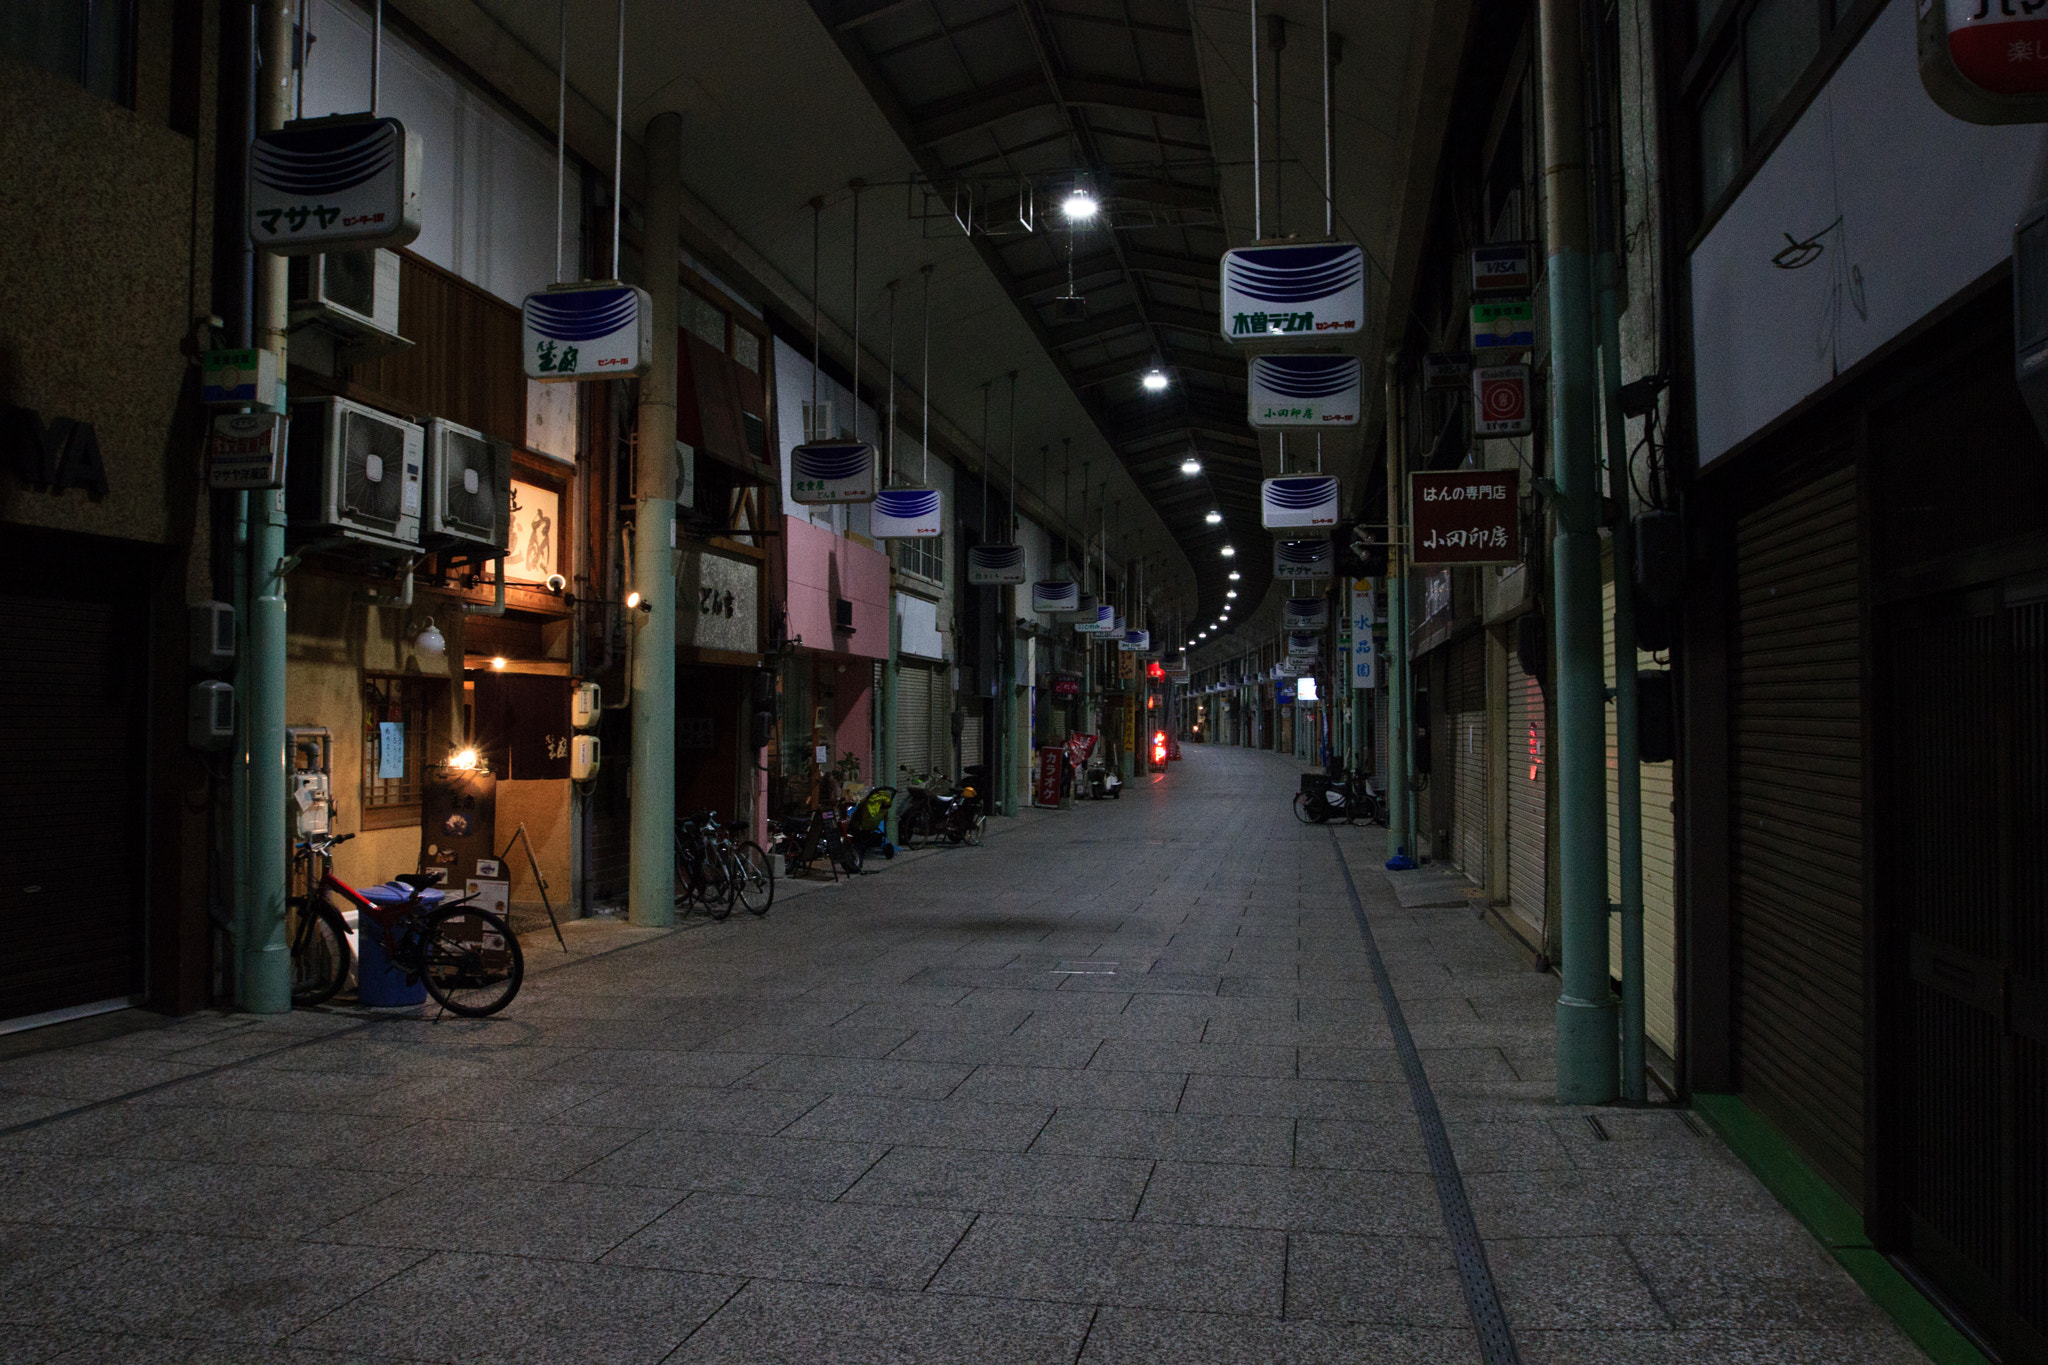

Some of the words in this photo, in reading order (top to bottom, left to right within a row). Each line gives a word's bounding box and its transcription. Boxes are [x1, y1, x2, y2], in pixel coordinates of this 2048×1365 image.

[256, 204, 341, 234] マサヤ
[1486, 261, 1516, 273] VISA
[598, 358, 629, 367] センター街
[1264, 408, 1313, 419] 小田印房
[796, 480, 825, 491] 定食屋
[1423, 485, 1507, 501] はんの専門店
[1423, 526, 1509, 550] 小田印房
[1044, 751, 1057, 800] カラオケ
